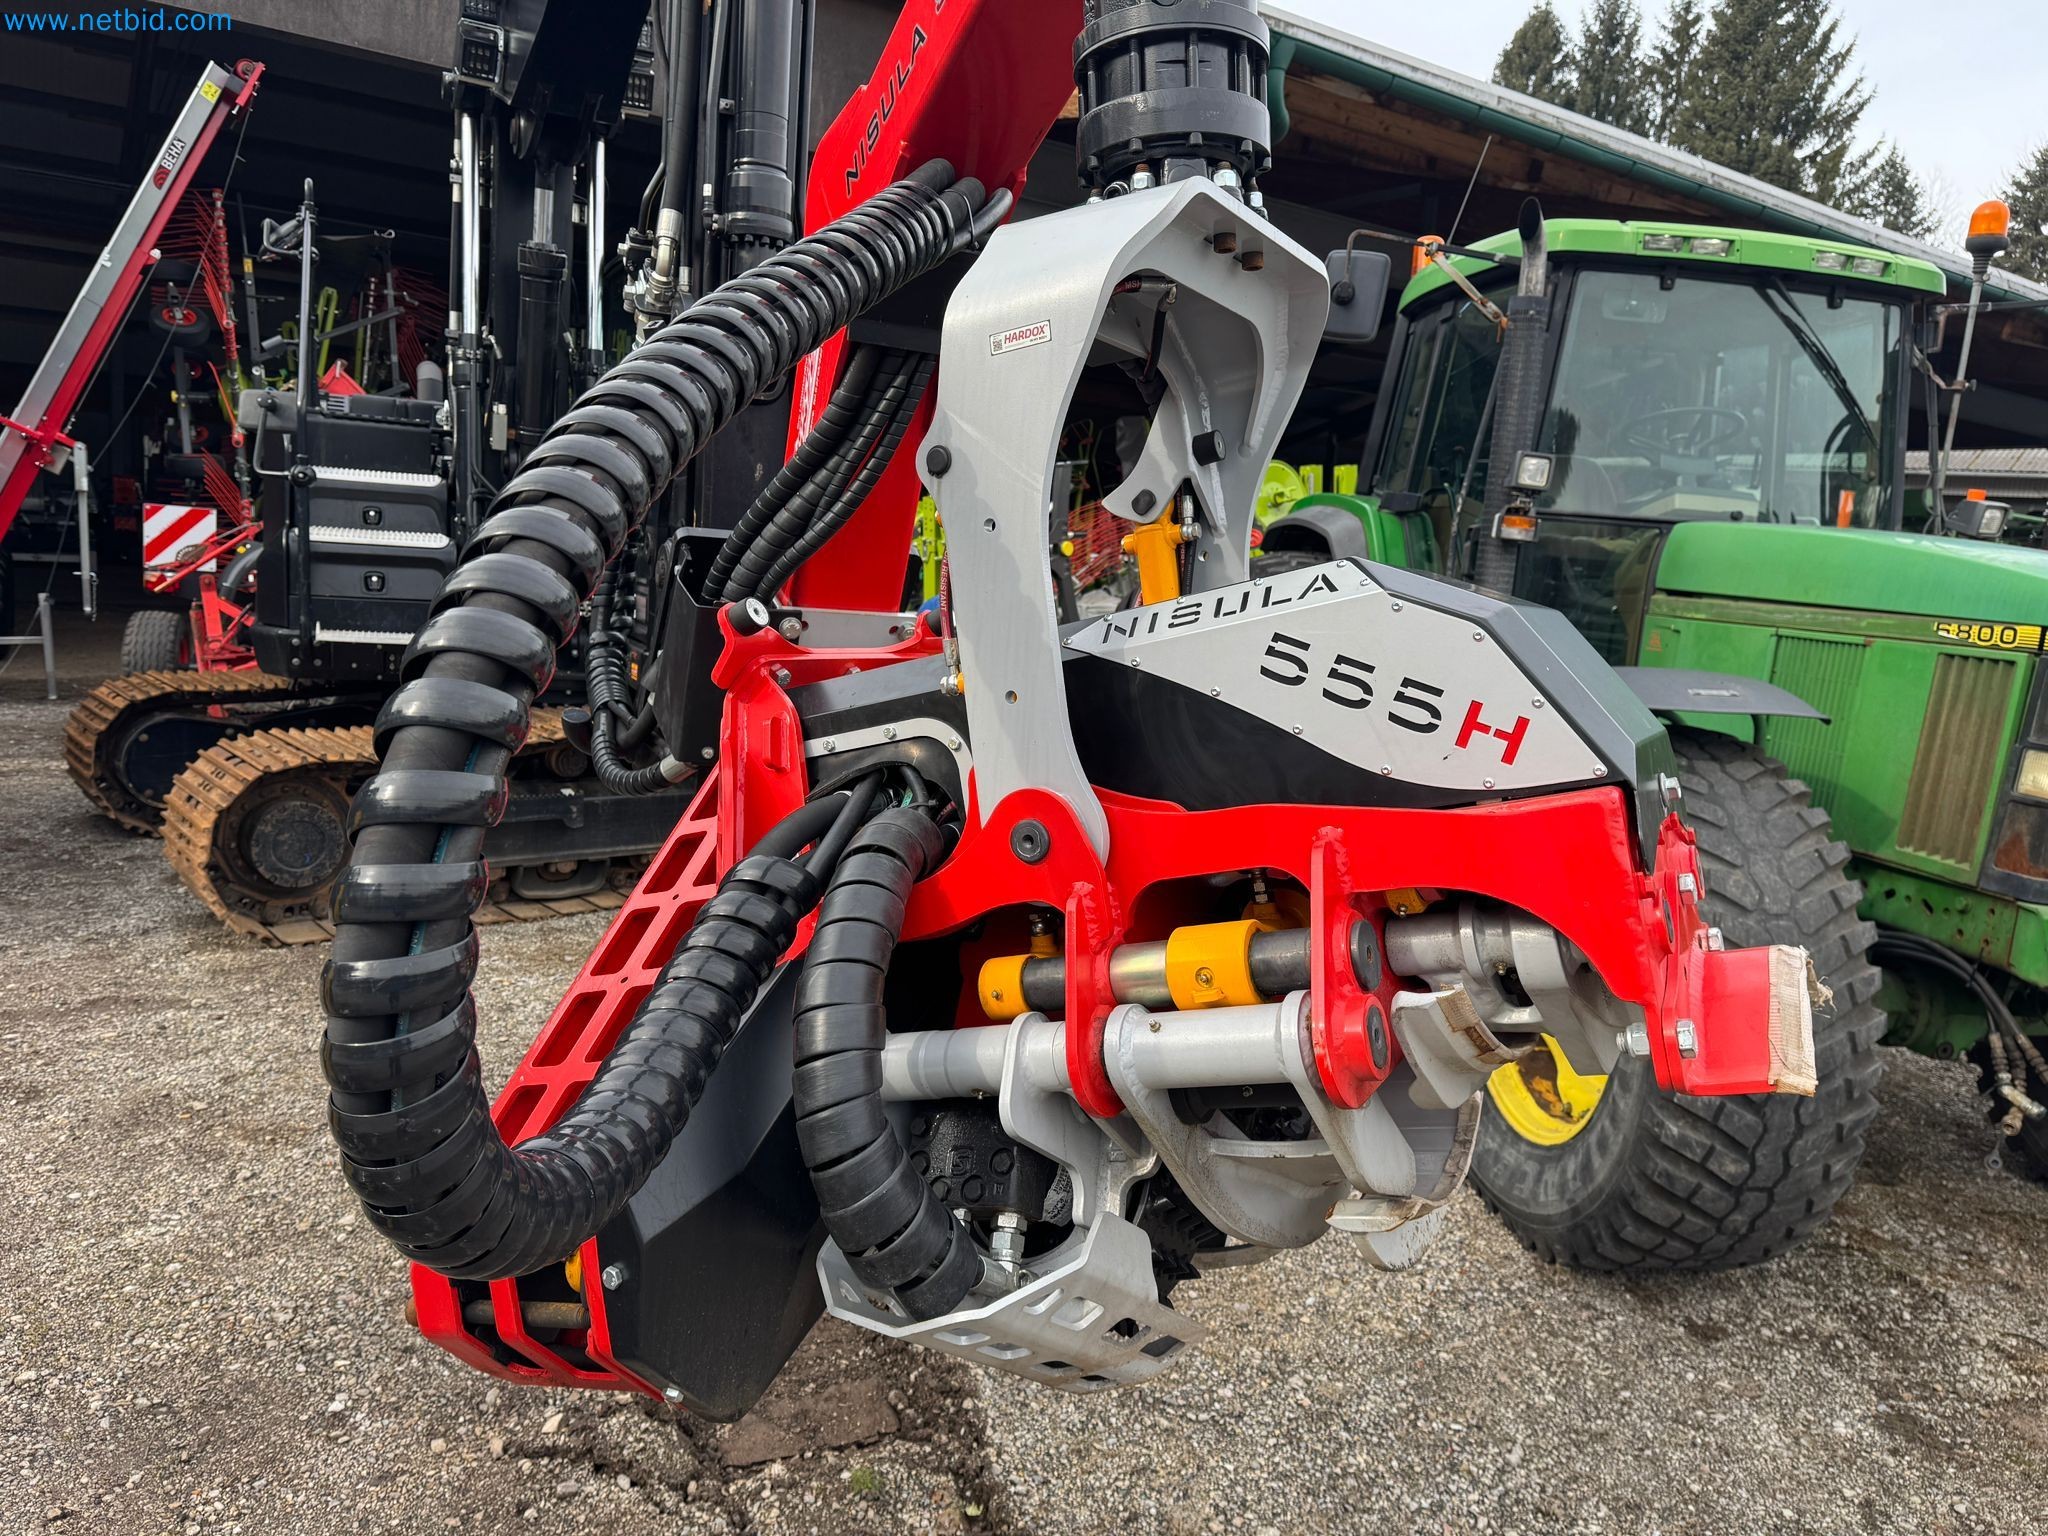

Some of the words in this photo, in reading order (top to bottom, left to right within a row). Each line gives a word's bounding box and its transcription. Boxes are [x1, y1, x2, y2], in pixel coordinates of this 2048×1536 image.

[846, 25, 927, 197] NISULA
[161, 139, 186, 170] BEHA
[1004, 323, 1046, 345] HARDOX
[1103, 573, 1339, 644] NISULA
[1260, 632, 1530, 765] 555H
